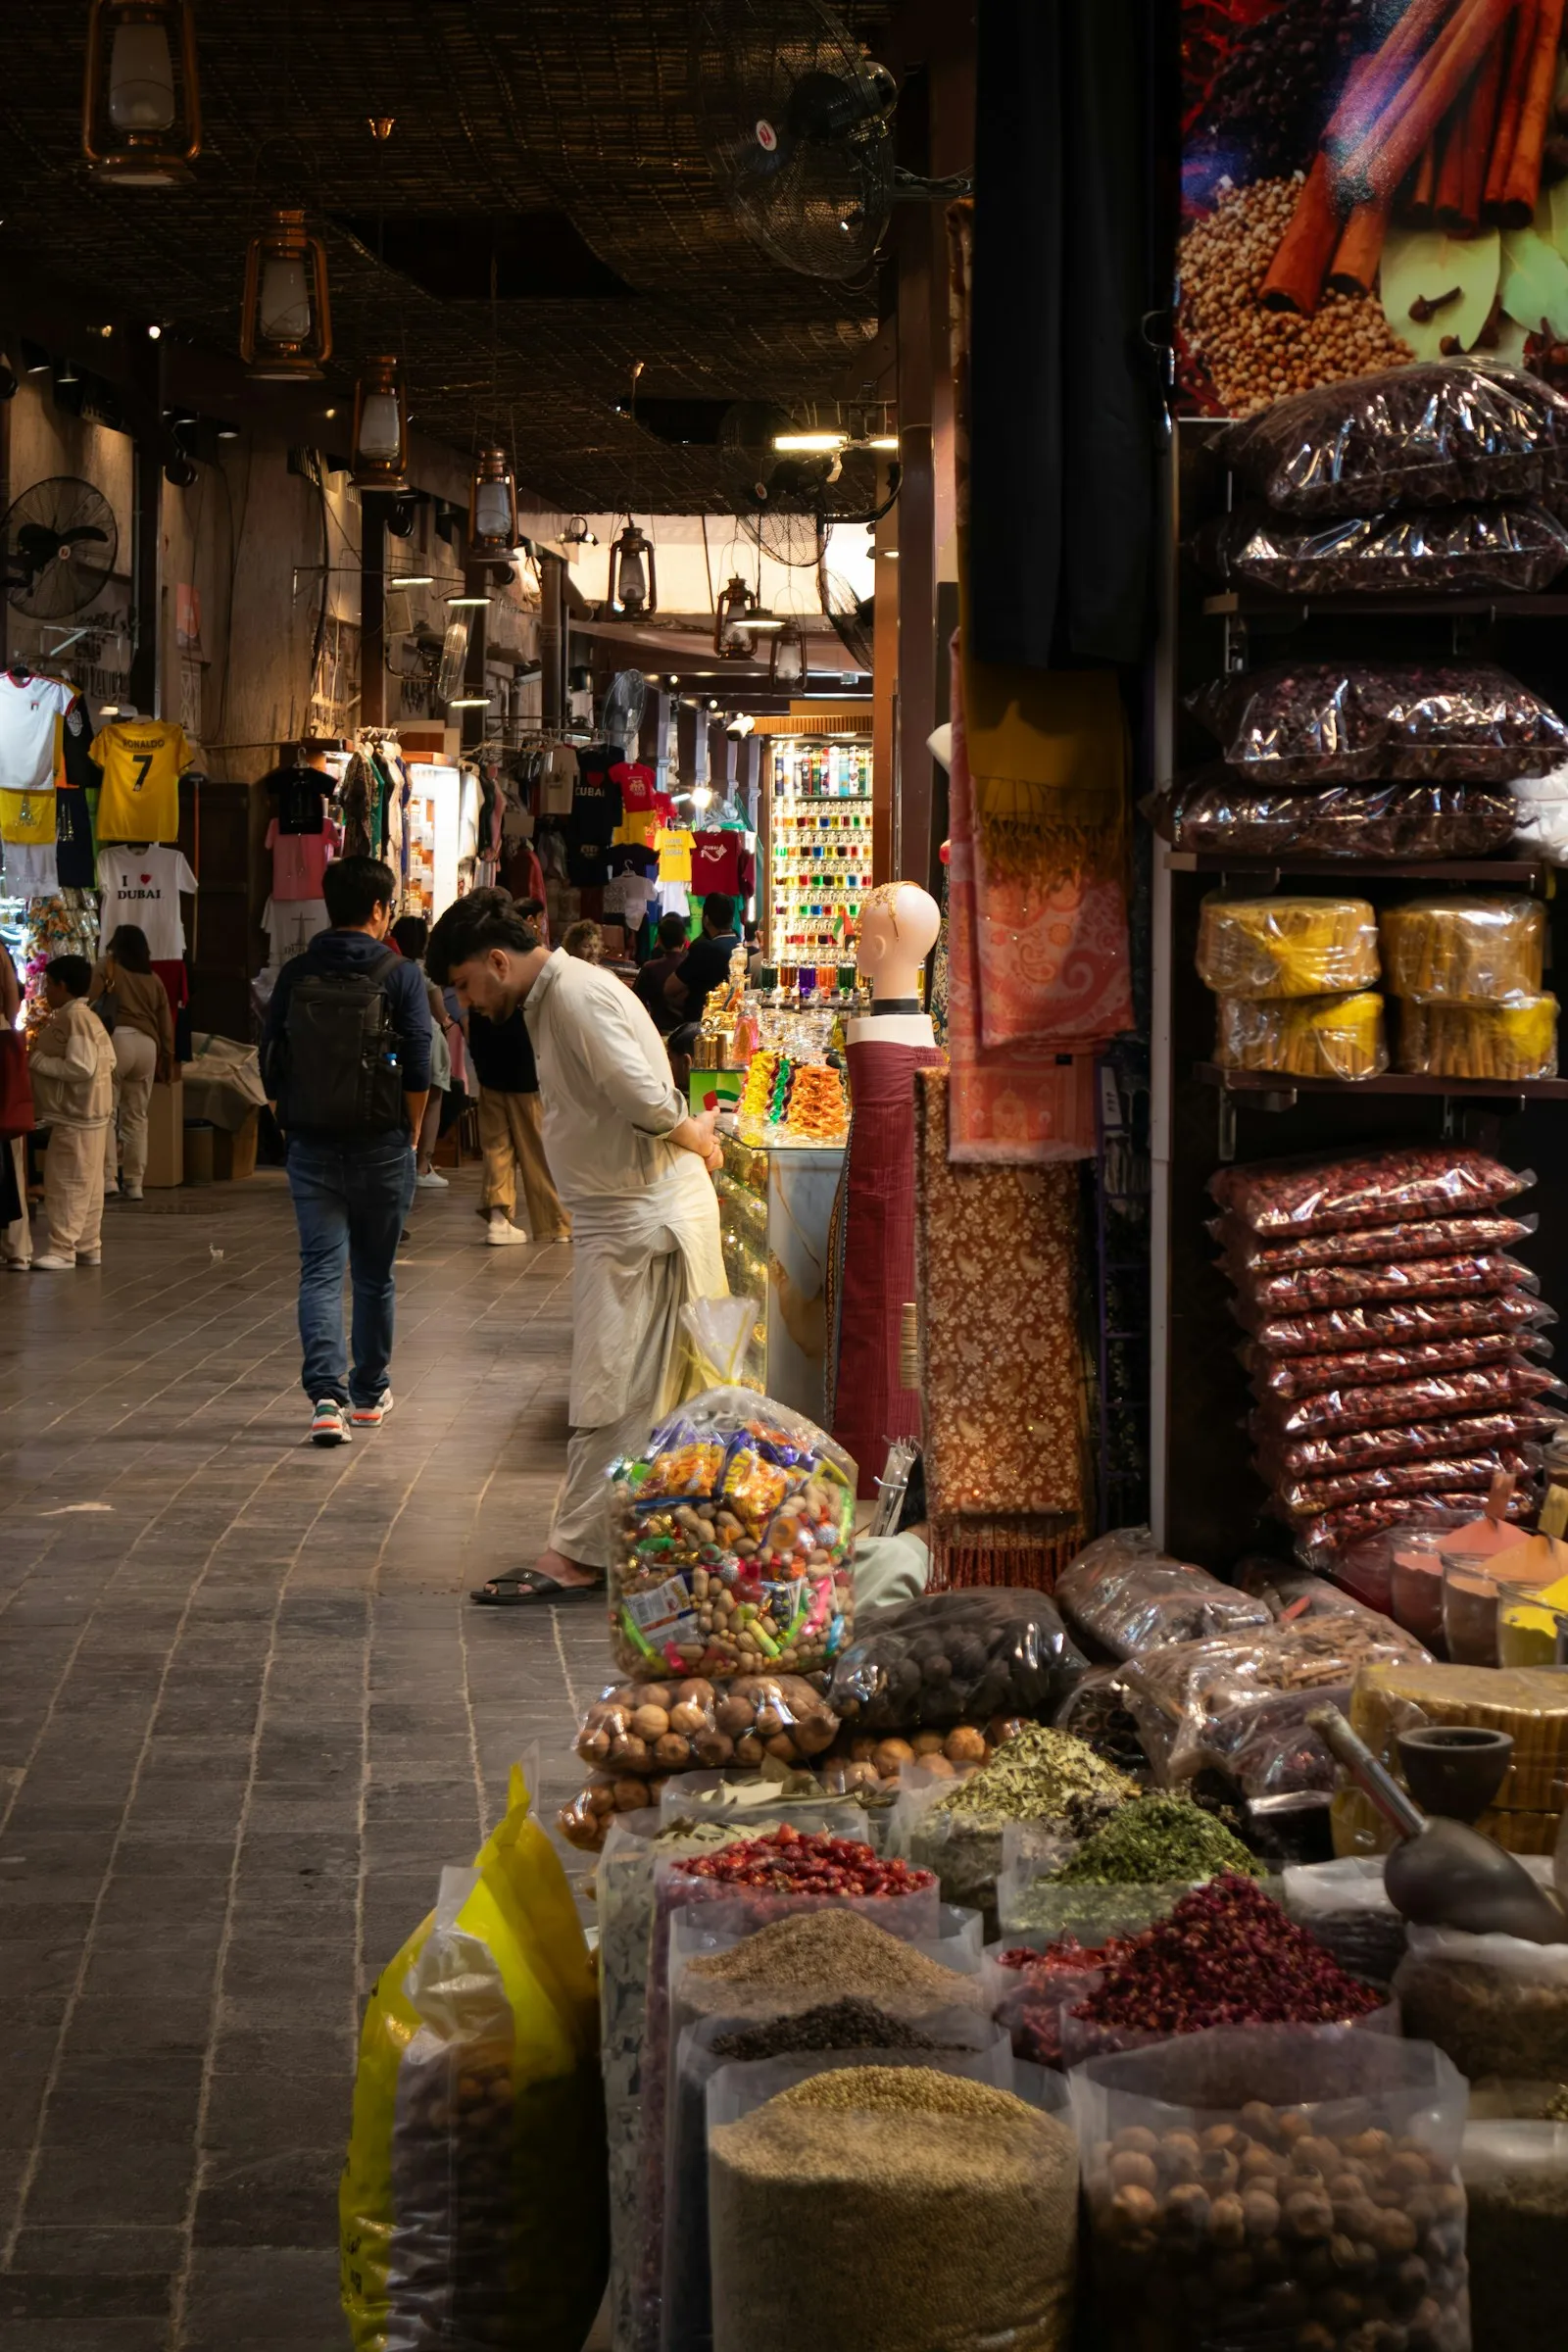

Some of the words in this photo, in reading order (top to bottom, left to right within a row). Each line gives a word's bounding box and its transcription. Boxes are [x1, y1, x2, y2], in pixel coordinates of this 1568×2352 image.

[122, 738, 165, 750] RONALDO
[132, 754, 153, 792] 7
[122, 874, 128, 887] I
[118, 889, 162, 900] DUBAI
